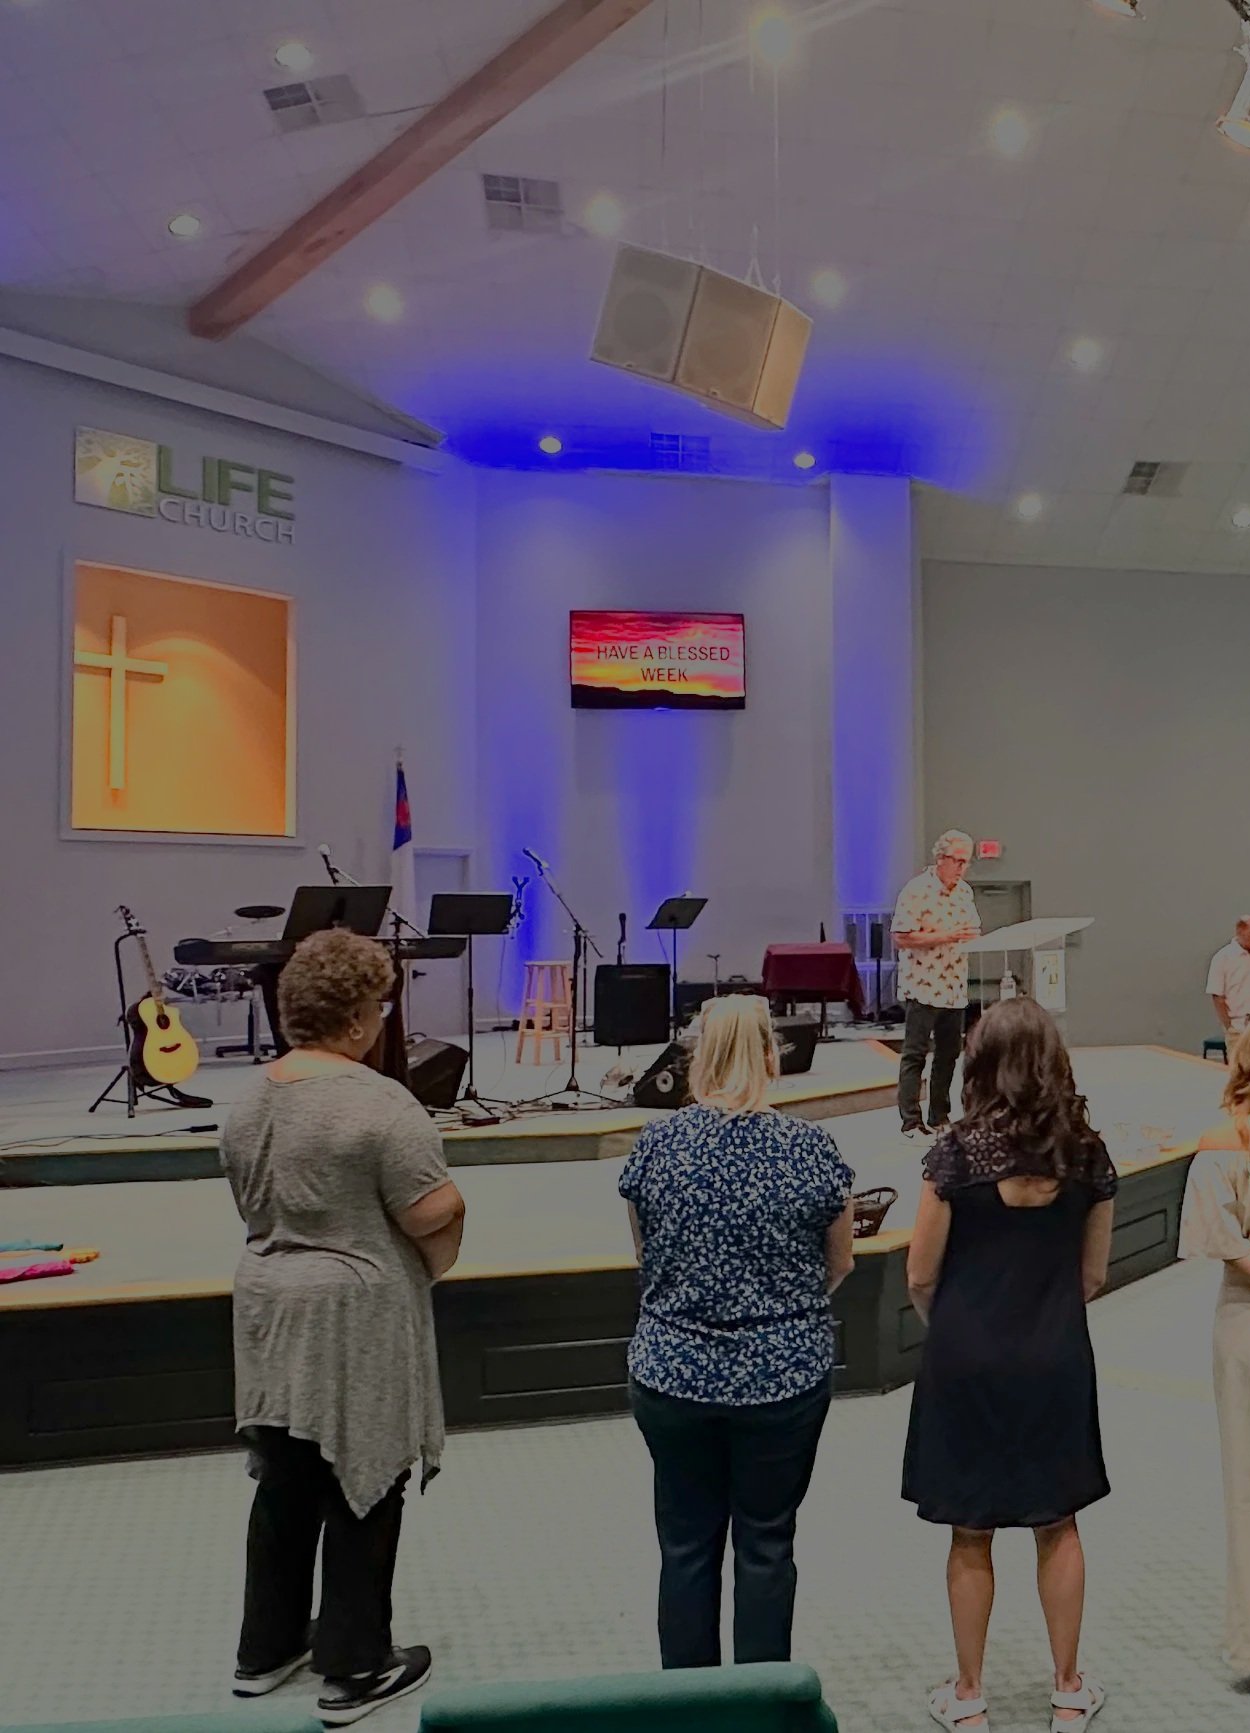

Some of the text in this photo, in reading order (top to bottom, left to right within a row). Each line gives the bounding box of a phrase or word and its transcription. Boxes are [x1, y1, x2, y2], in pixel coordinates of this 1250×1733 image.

[157, 444, 295, 521] LIFE
[158, 498, 295, 544] CHURCH
[597, 645, 731, 661] HAVE A BLESSED
[640, 668, 689, 682] WEEK
